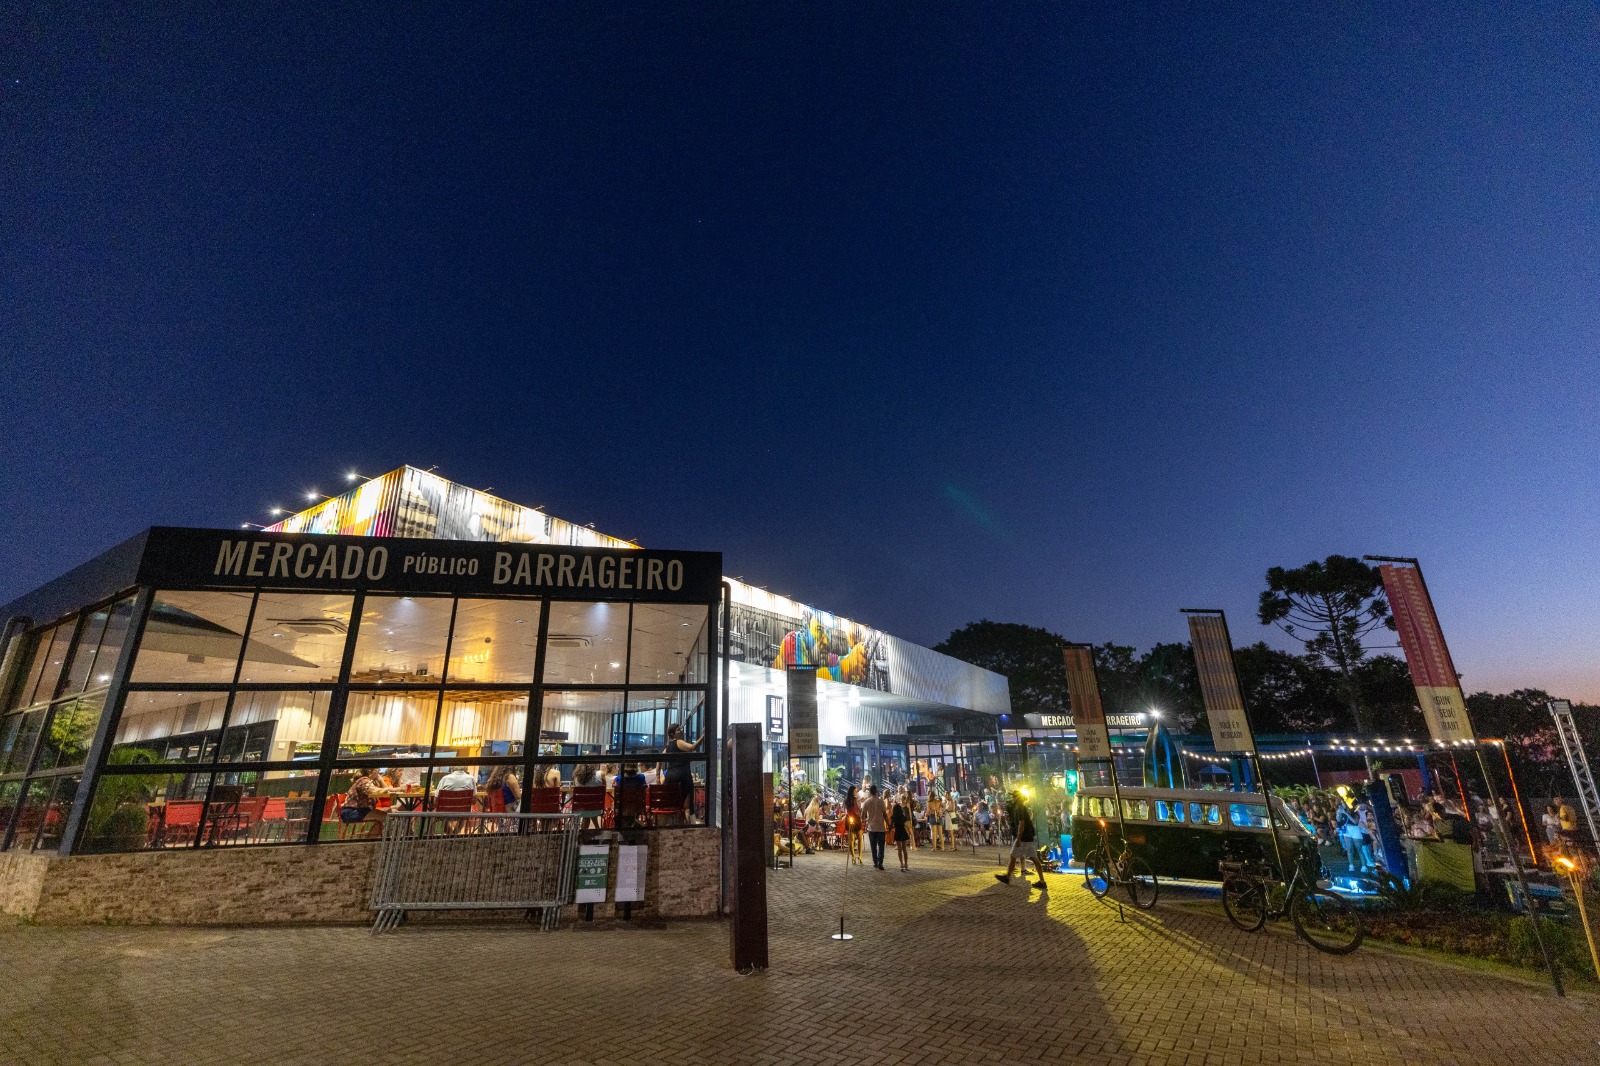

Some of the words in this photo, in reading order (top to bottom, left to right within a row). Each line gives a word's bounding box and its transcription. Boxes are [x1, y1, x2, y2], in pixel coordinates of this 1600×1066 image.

[213, 541, 389, 581] MERCADO
[403, 555, 479, 577] PÚBLICO
[492, 551, 684, 592] BARRAGEIRO
